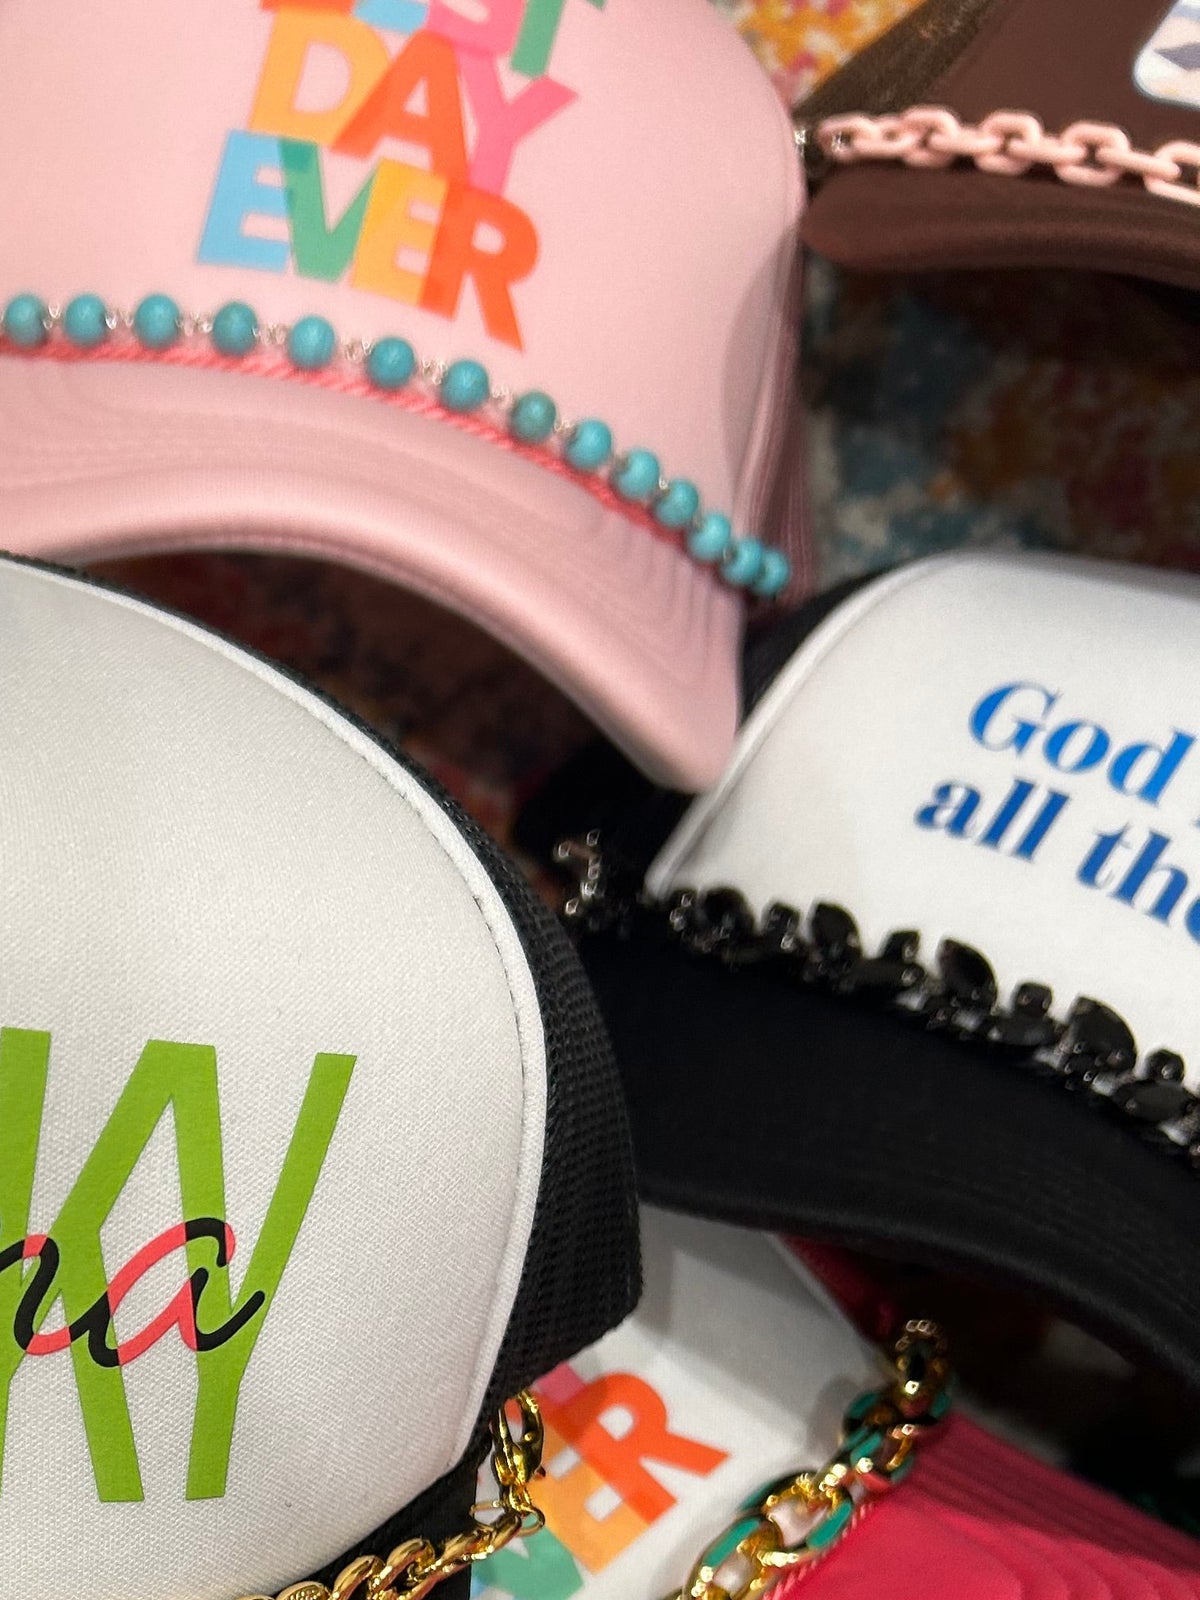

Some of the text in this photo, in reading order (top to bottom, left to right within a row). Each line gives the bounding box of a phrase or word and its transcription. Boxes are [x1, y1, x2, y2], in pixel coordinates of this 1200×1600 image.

[246, 5, 579, 200] DAY
[197, 129, 540, 352] EVER
[912, 777, 1071, 864] all
[967, 680, 1197, 807] God
